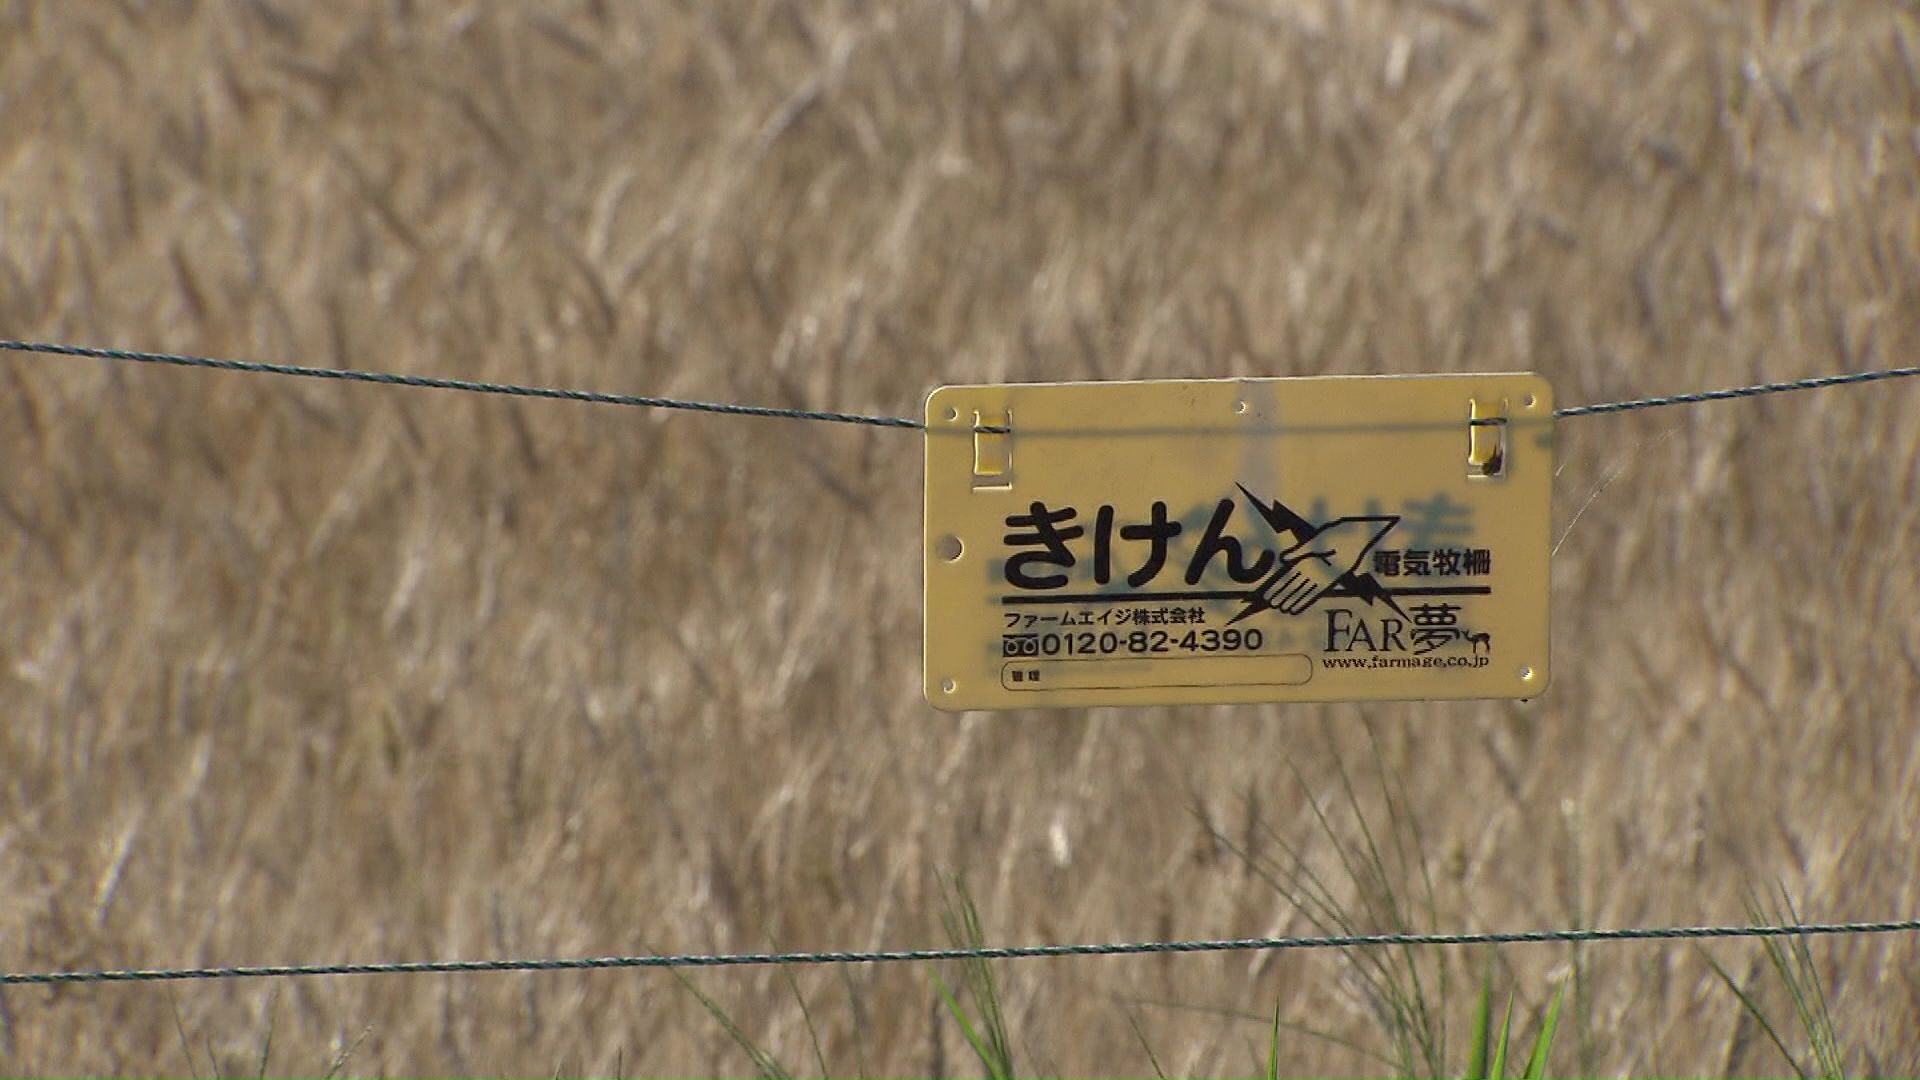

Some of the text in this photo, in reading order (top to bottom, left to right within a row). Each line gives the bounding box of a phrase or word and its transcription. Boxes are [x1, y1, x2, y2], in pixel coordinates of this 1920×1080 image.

[1003, 499, 1275, 590] きけん
[1003, 607, 1206, 628] ファームエイジ株式会社
[1042, 629, 1263, 655] 0120-82-4390
[1322, 654, 1490, 669] www.farmage.co.jp
